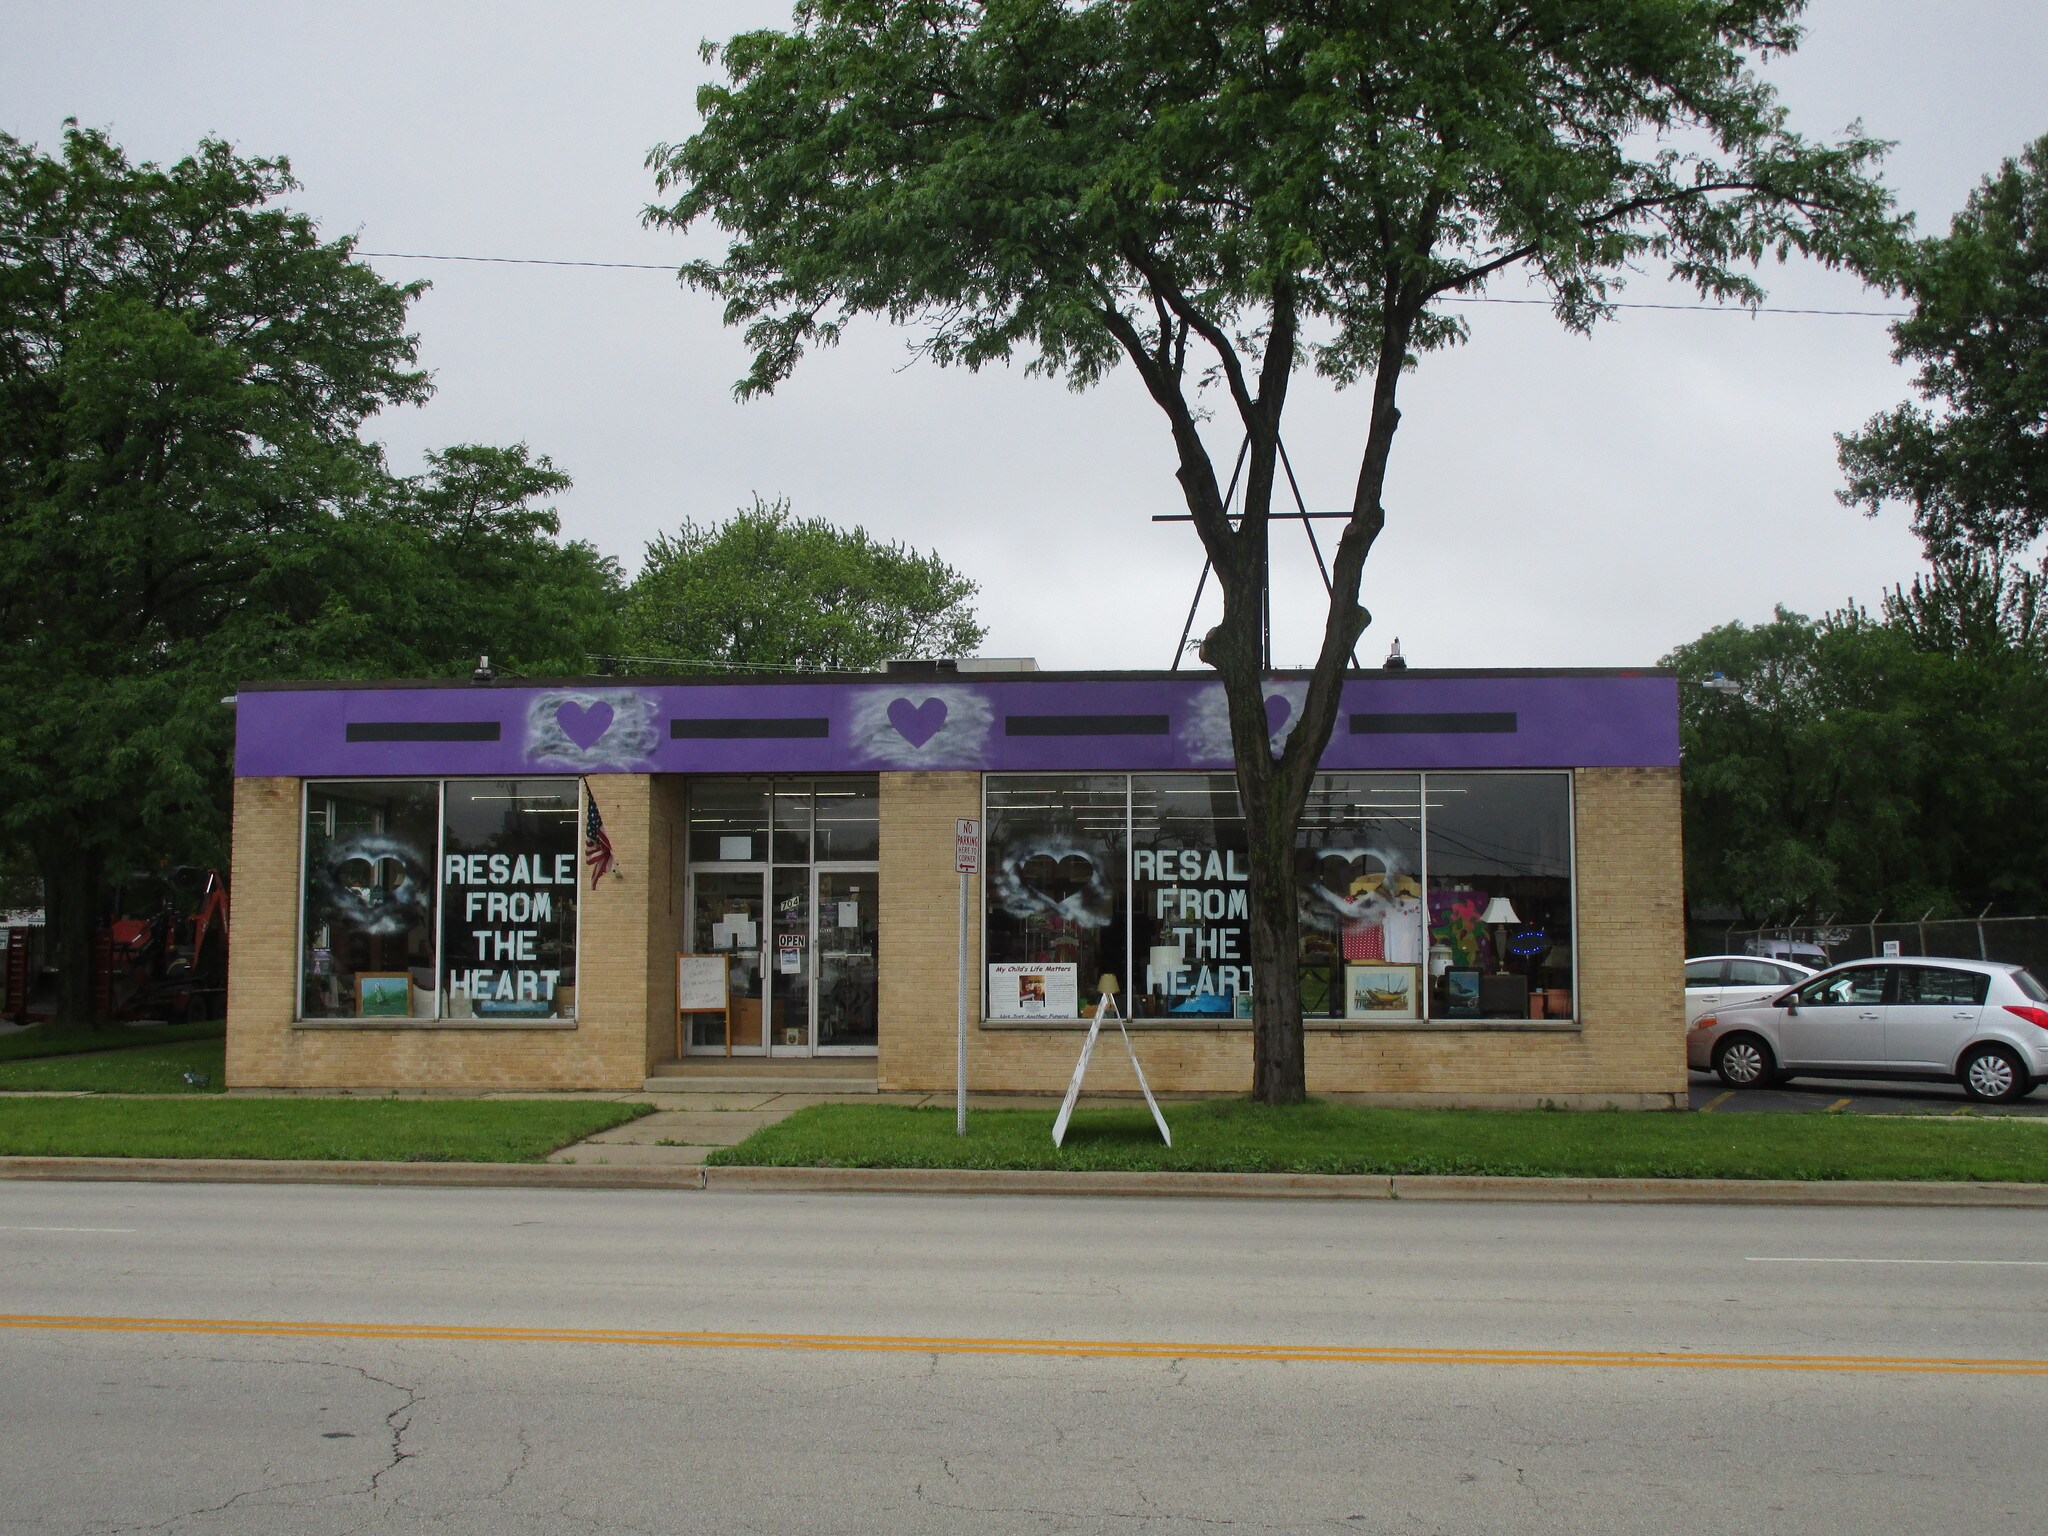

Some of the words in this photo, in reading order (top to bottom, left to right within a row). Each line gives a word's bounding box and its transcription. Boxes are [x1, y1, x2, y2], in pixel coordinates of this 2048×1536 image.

[957, 835, 978, 847] PARKING
[963, 824, 973, 834] NO
[971, 847, 978, 855] TO
[1134, 850, 1249, 881] RESAL
[445, 854, 575, 884] RESALE
[466, 892, 552, 922] FROM
[781, 897, 799, 910] 704
[1157, 889, 1249, 920] FROM
[472, 930, 538, 961] THE
[780, 935, 805, 946] OPEN
[1172, 928, 1241, 959] THE
[450, 969, 561, 1000] HEART
